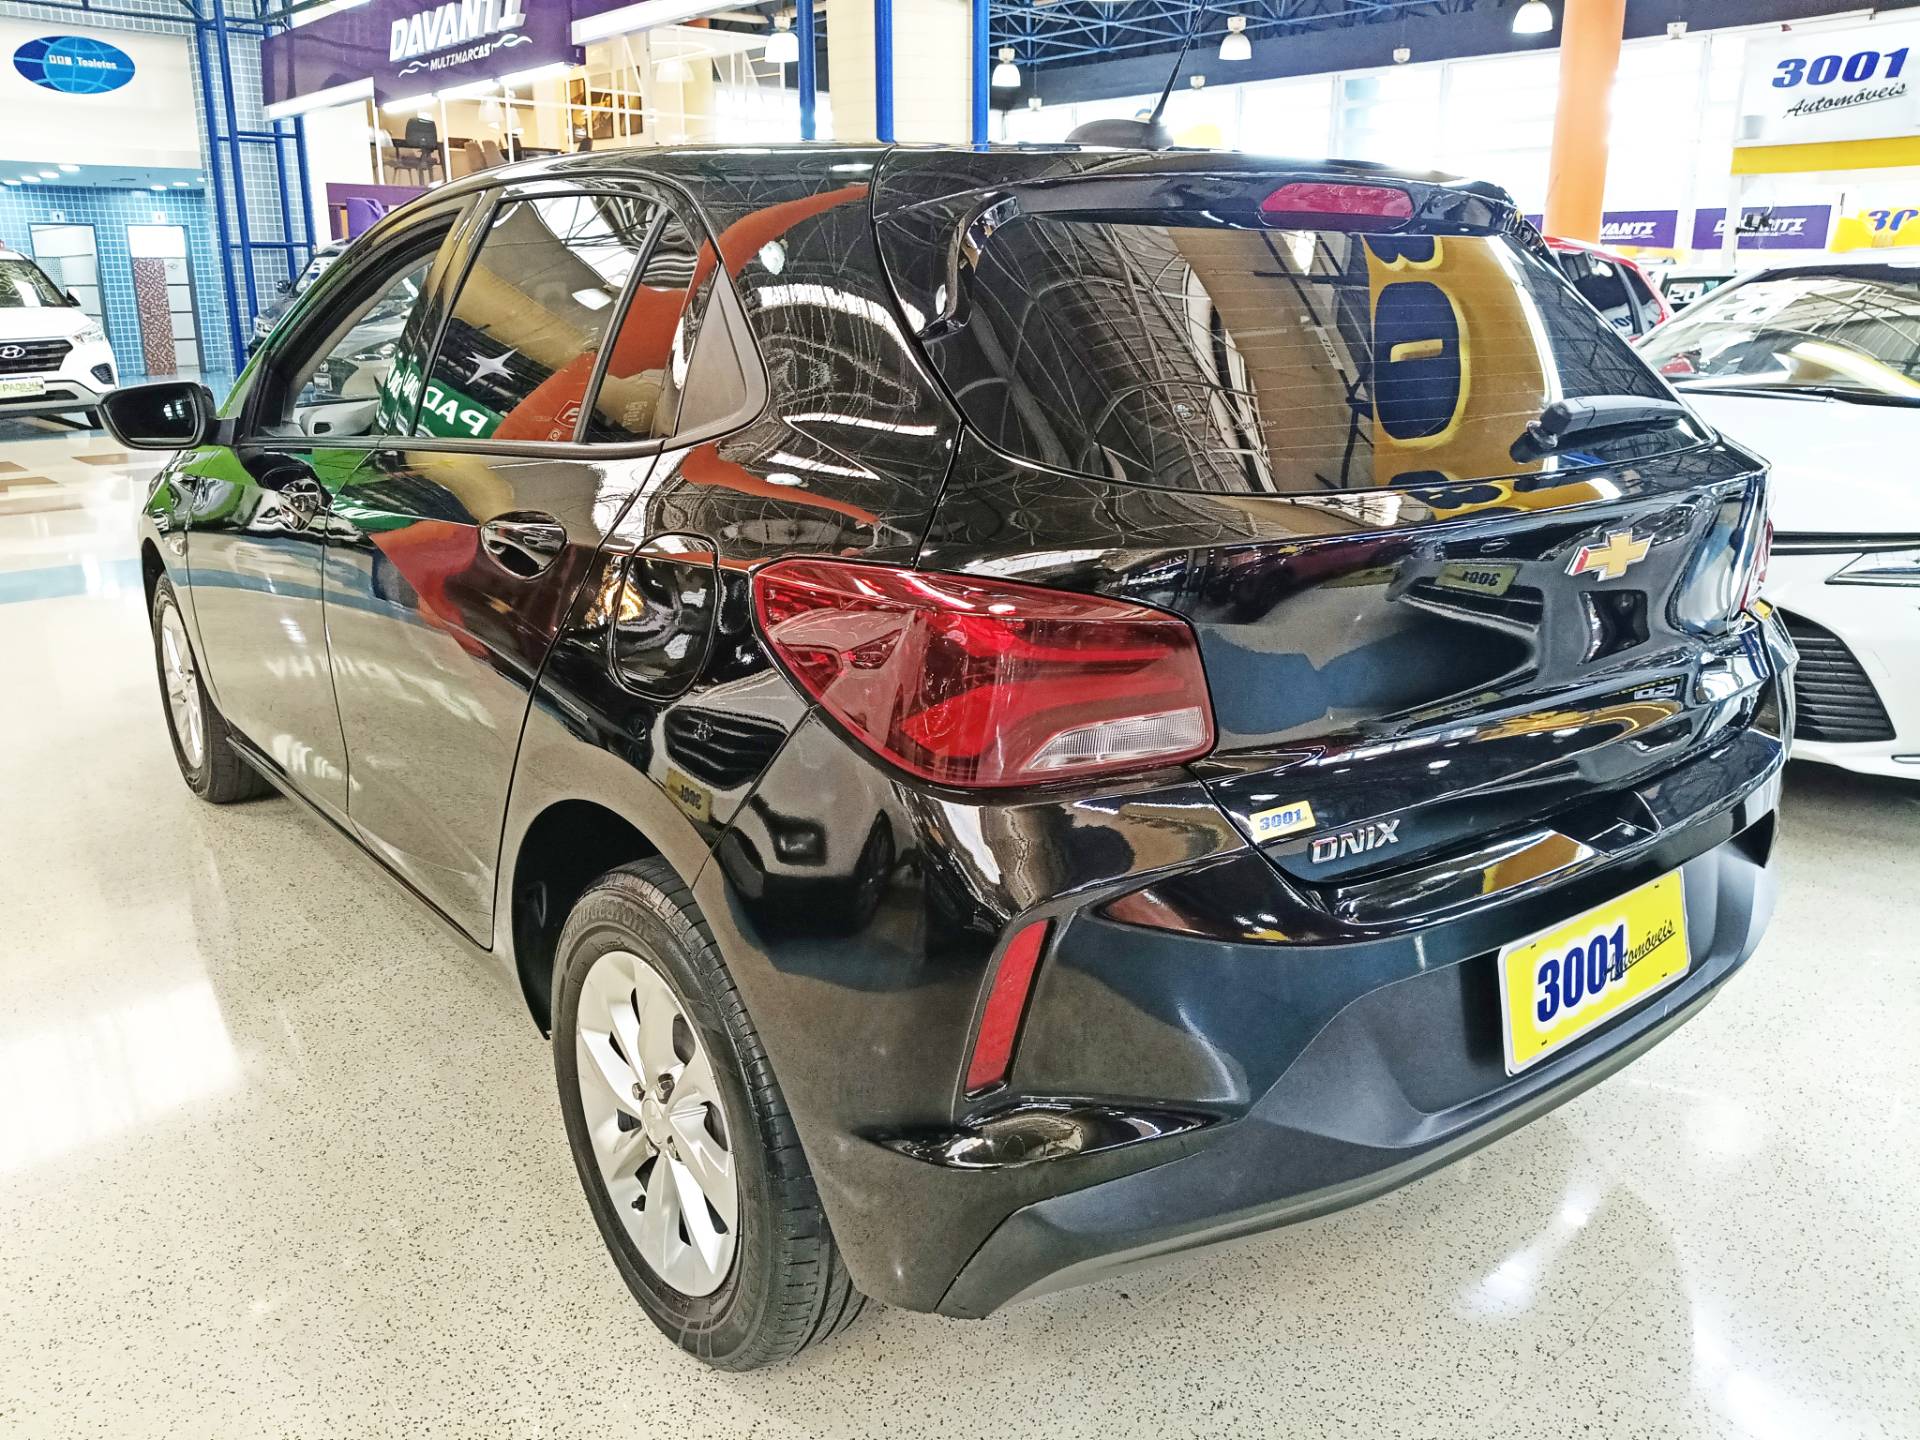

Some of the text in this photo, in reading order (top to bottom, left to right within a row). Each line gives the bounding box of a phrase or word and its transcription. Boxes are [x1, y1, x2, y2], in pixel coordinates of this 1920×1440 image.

[430, 42, 493, 72] MULTIMARCAS
[1772, 47, 1909, 88] 3001
[1259, 808, 1303, 831] 3001
[1308, 818, 1401, 865] ONIX
[1537, 924, 1625, 1023] 3001
